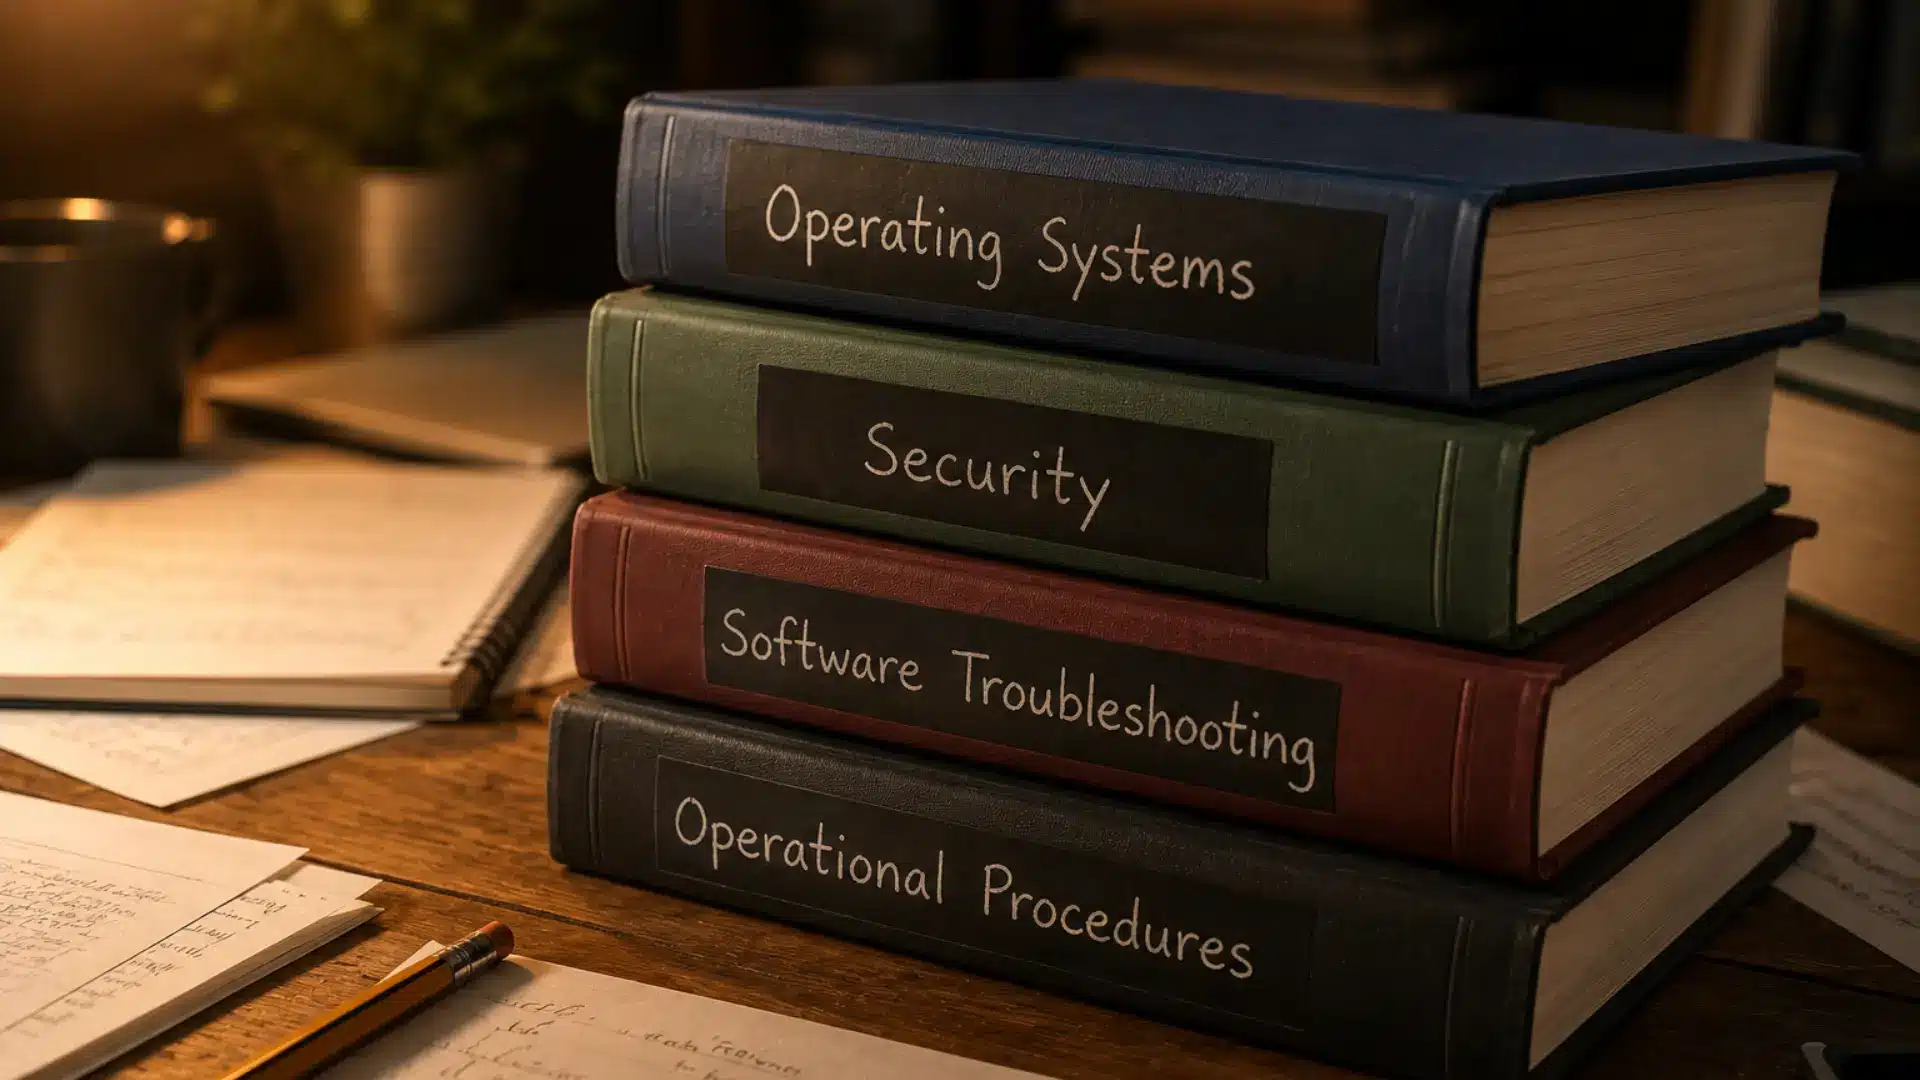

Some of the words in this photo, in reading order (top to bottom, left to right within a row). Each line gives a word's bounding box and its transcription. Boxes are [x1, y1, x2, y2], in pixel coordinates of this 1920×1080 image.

[766, 184, 1002, 291] Operating
[1038, 217, 1255, 302] Systems
[865, 422, 1111, 532] Security
[721, 608, 923, 692] Software
[952, 650, 1315, 793] Troubleshooting
[676, 797, 944, 904] Operational
[984, 864, 1253, 979] Procedures
